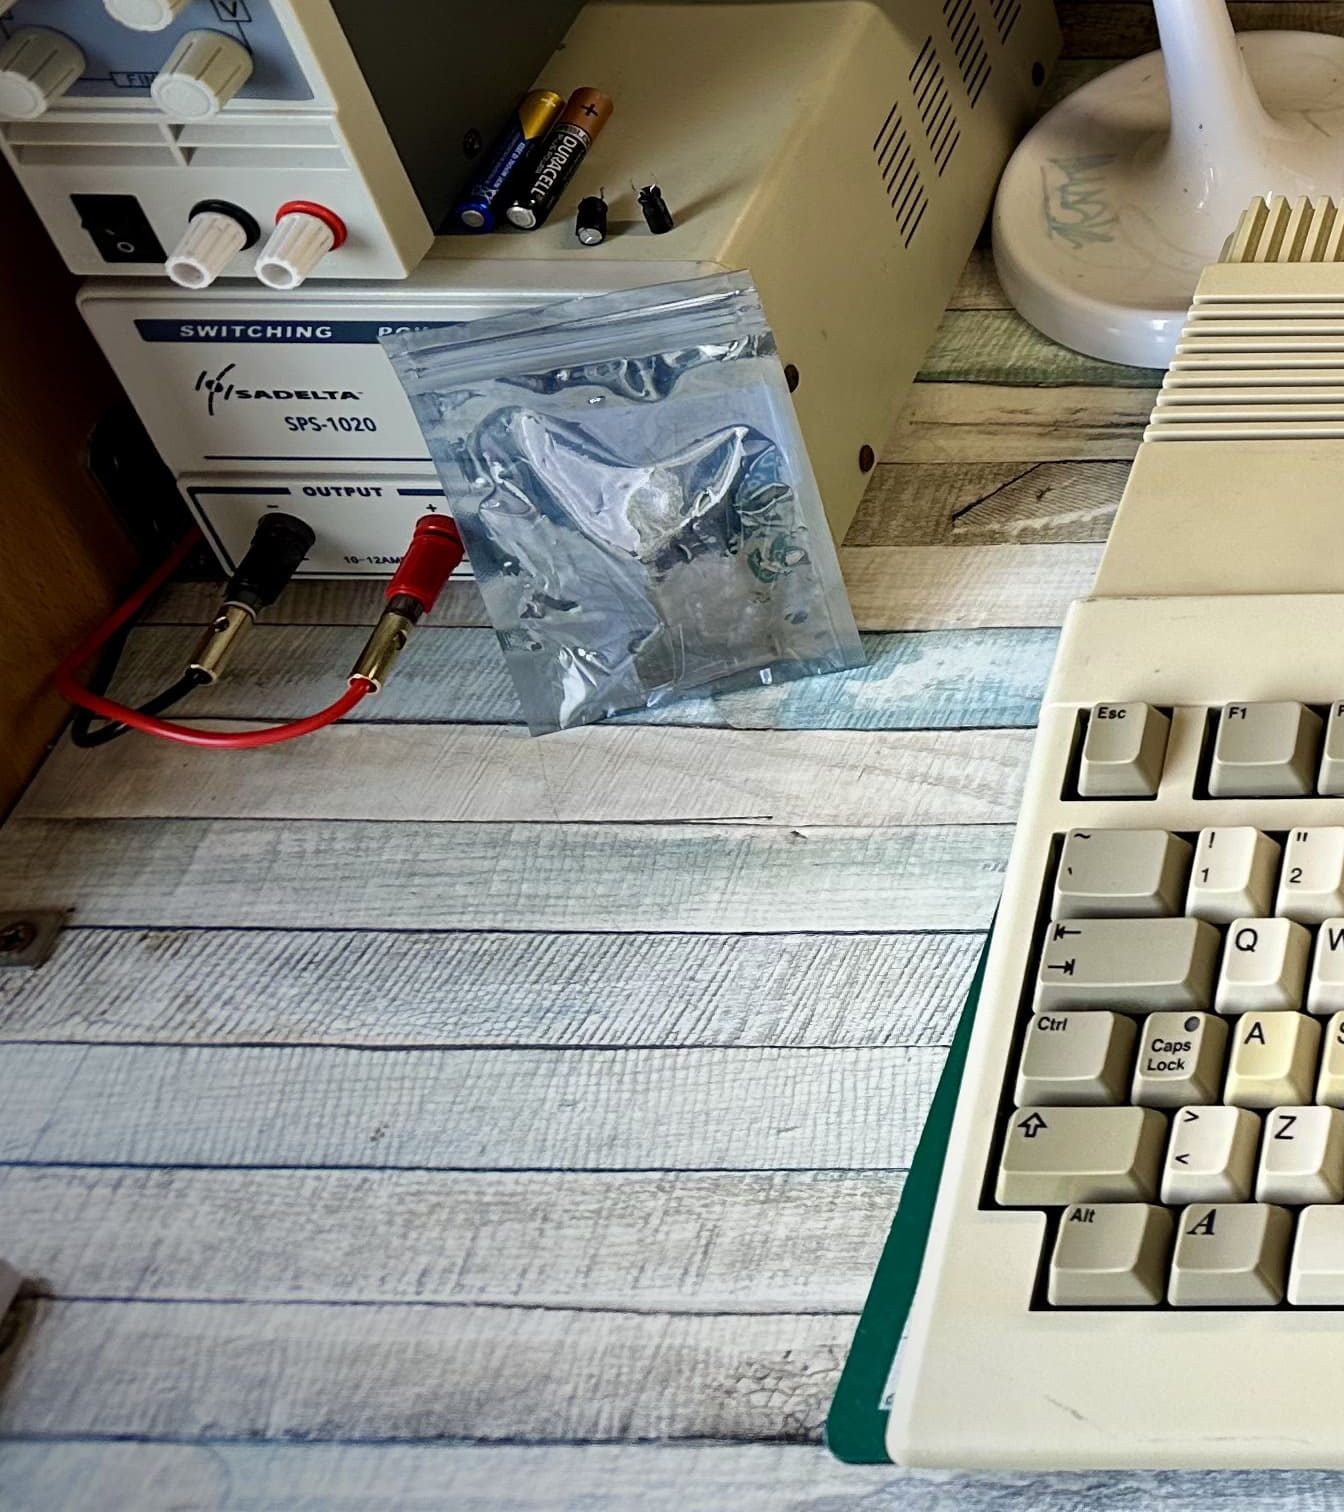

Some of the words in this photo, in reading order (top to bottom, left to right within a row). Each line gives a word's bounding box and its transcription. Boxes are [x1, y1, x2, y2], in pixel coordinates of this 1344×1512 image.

[218, 0, 238, 18] V
[530, 134, 578, 198] DURACELL
[179, 324, 333, 339] SWITCHING
[284, 416, 377, 433] SPS-1020
[302, 486, 384, 498] OUTPUT
[1097, 706, 1126, 720] Esc
[1228, 706, 1247, 720] F1
[1235, 928, 1258, 953] Q
[1036, 1016, 1068, 1032] Ctrl
[1151, 1038, 1191, 1054] Caps
[1147, 1057, 1185, 1072] Lock
[1070, 1207, 1096, 1223] Alt
